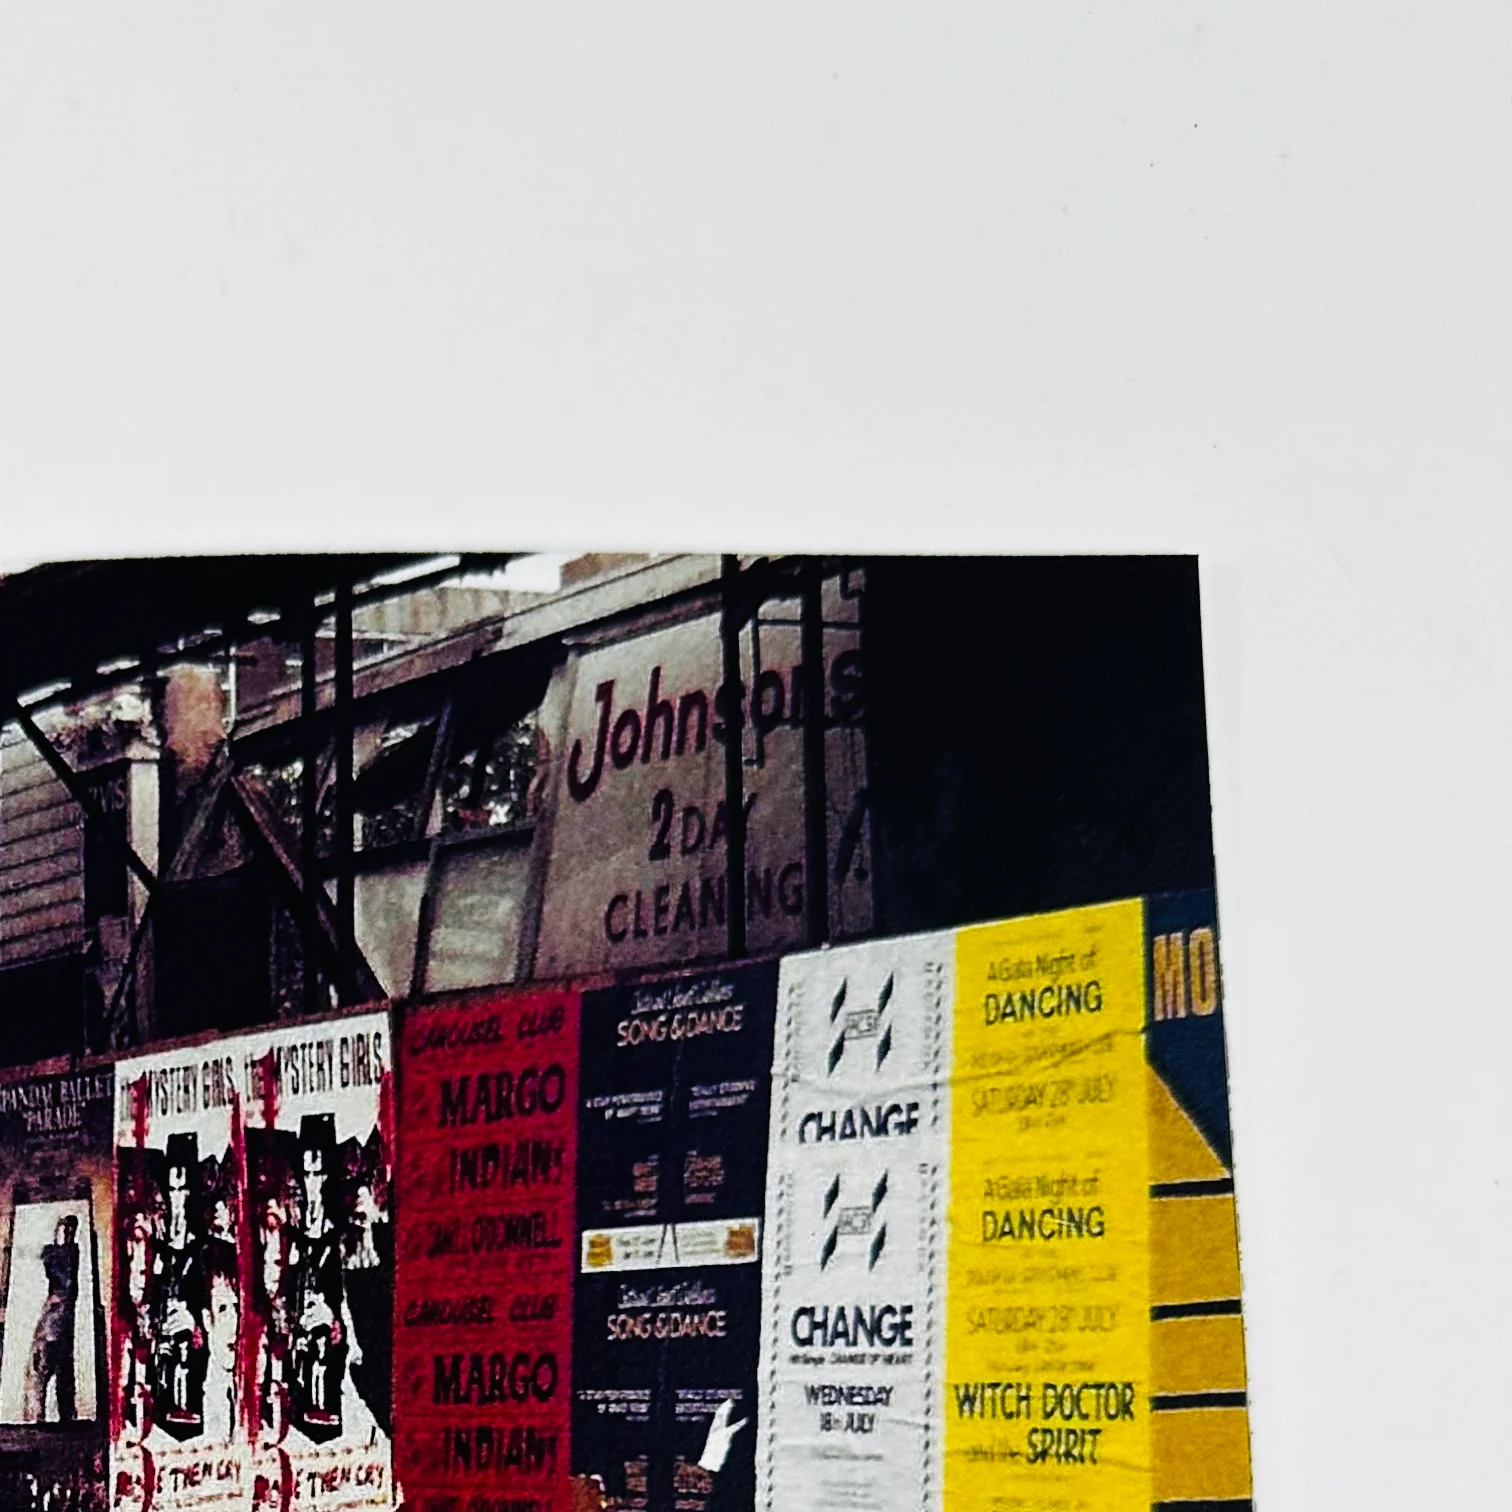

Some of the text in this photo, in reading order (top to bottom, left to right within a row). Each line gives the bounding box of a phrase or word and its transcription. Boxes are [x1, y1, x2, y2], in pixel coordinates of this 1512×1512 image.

[604, 862, 806, 944] CLEANNG
[984, 979, 1104, 1027] DANCING
[616, 1014, 668, 1047] SONG
[687, 1004, 745, 1038] DANCE
[339, 1031, 383, 1089] GIRLS
[202, 1055, 235, 1110] GIRLS
[438, 1061, 567, 1128] MARGO
[797, 1101, 921, 1145] CHANGE
[982, 1206, 1106, 1243] DANCING
[606, 1311, 652, 1341] SONG
[670, 1309, 727, 1338] DANCE
[790, 1304, 914, 1348] CHANGE
[432, 1351, 559, 1406] MARGO
[803, 1383, 894, 1407] WEDNESDAY
[843, 1411, 876, 1434] JULY
[953, 1381, 1135, 1422] WITCH DOCTOR
[1025, 1426, 1104, 1466] SPIRIT
